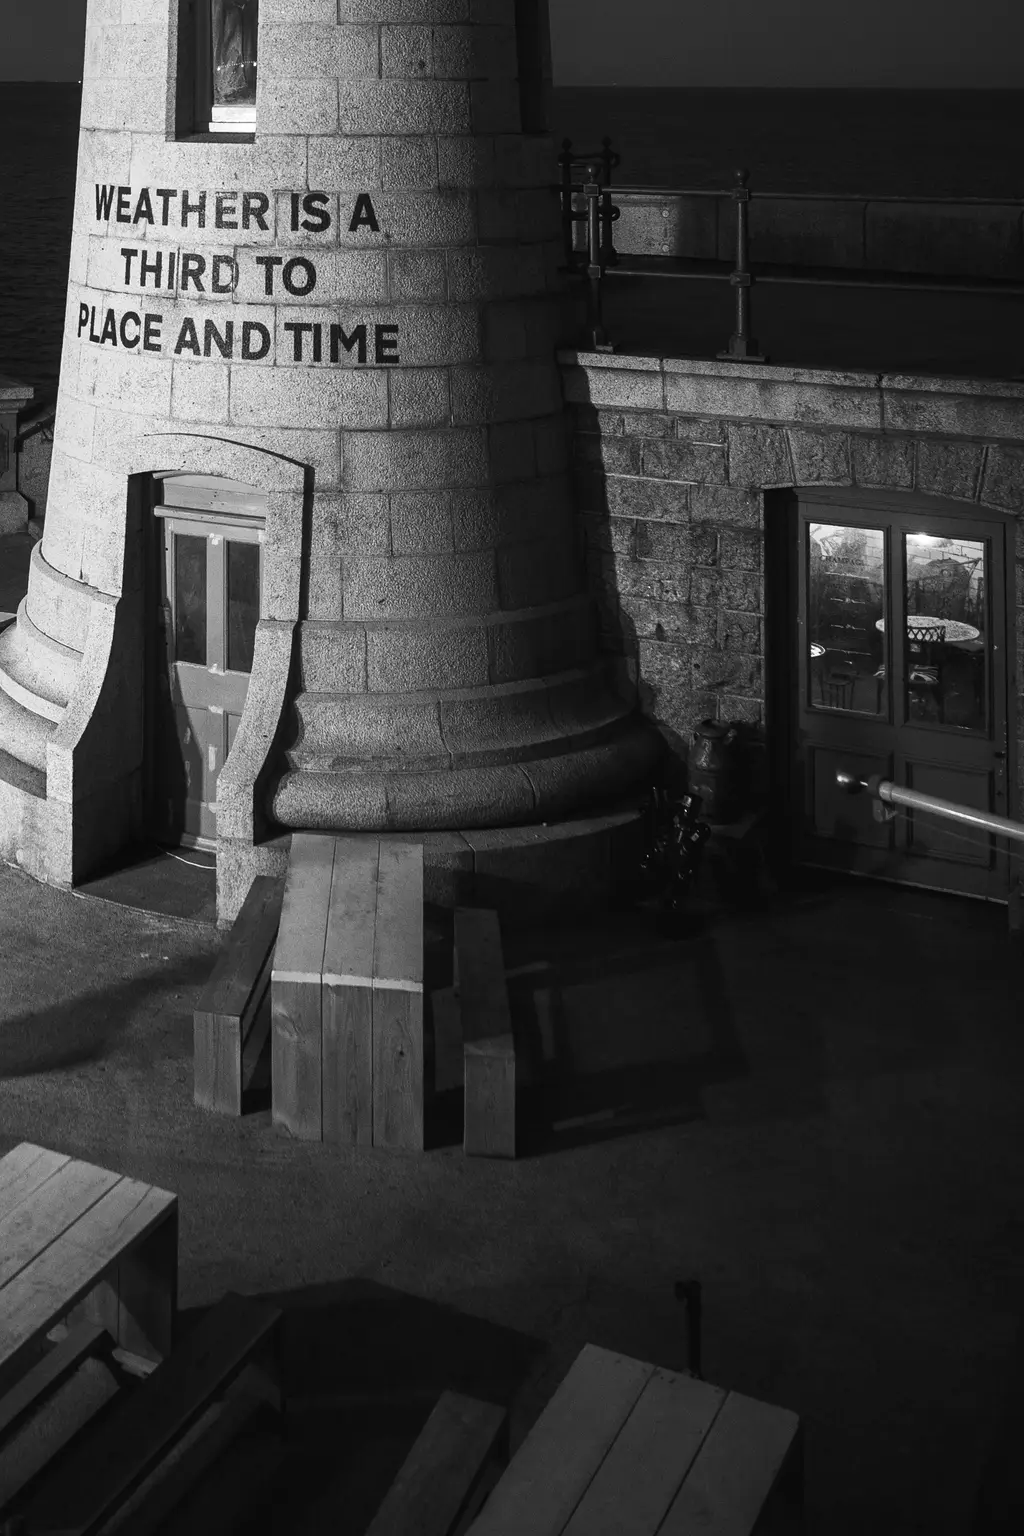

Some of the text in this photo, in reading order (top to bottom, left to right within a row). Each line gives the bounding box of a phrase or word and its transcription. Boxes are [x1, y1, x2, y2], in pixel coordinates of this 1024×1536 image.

[94, 183, 381, 234] WEATHER IS A
[120, 247, 318, 297] THIRD TO
[77, 301, 401, 364] PLACE AND TIME
